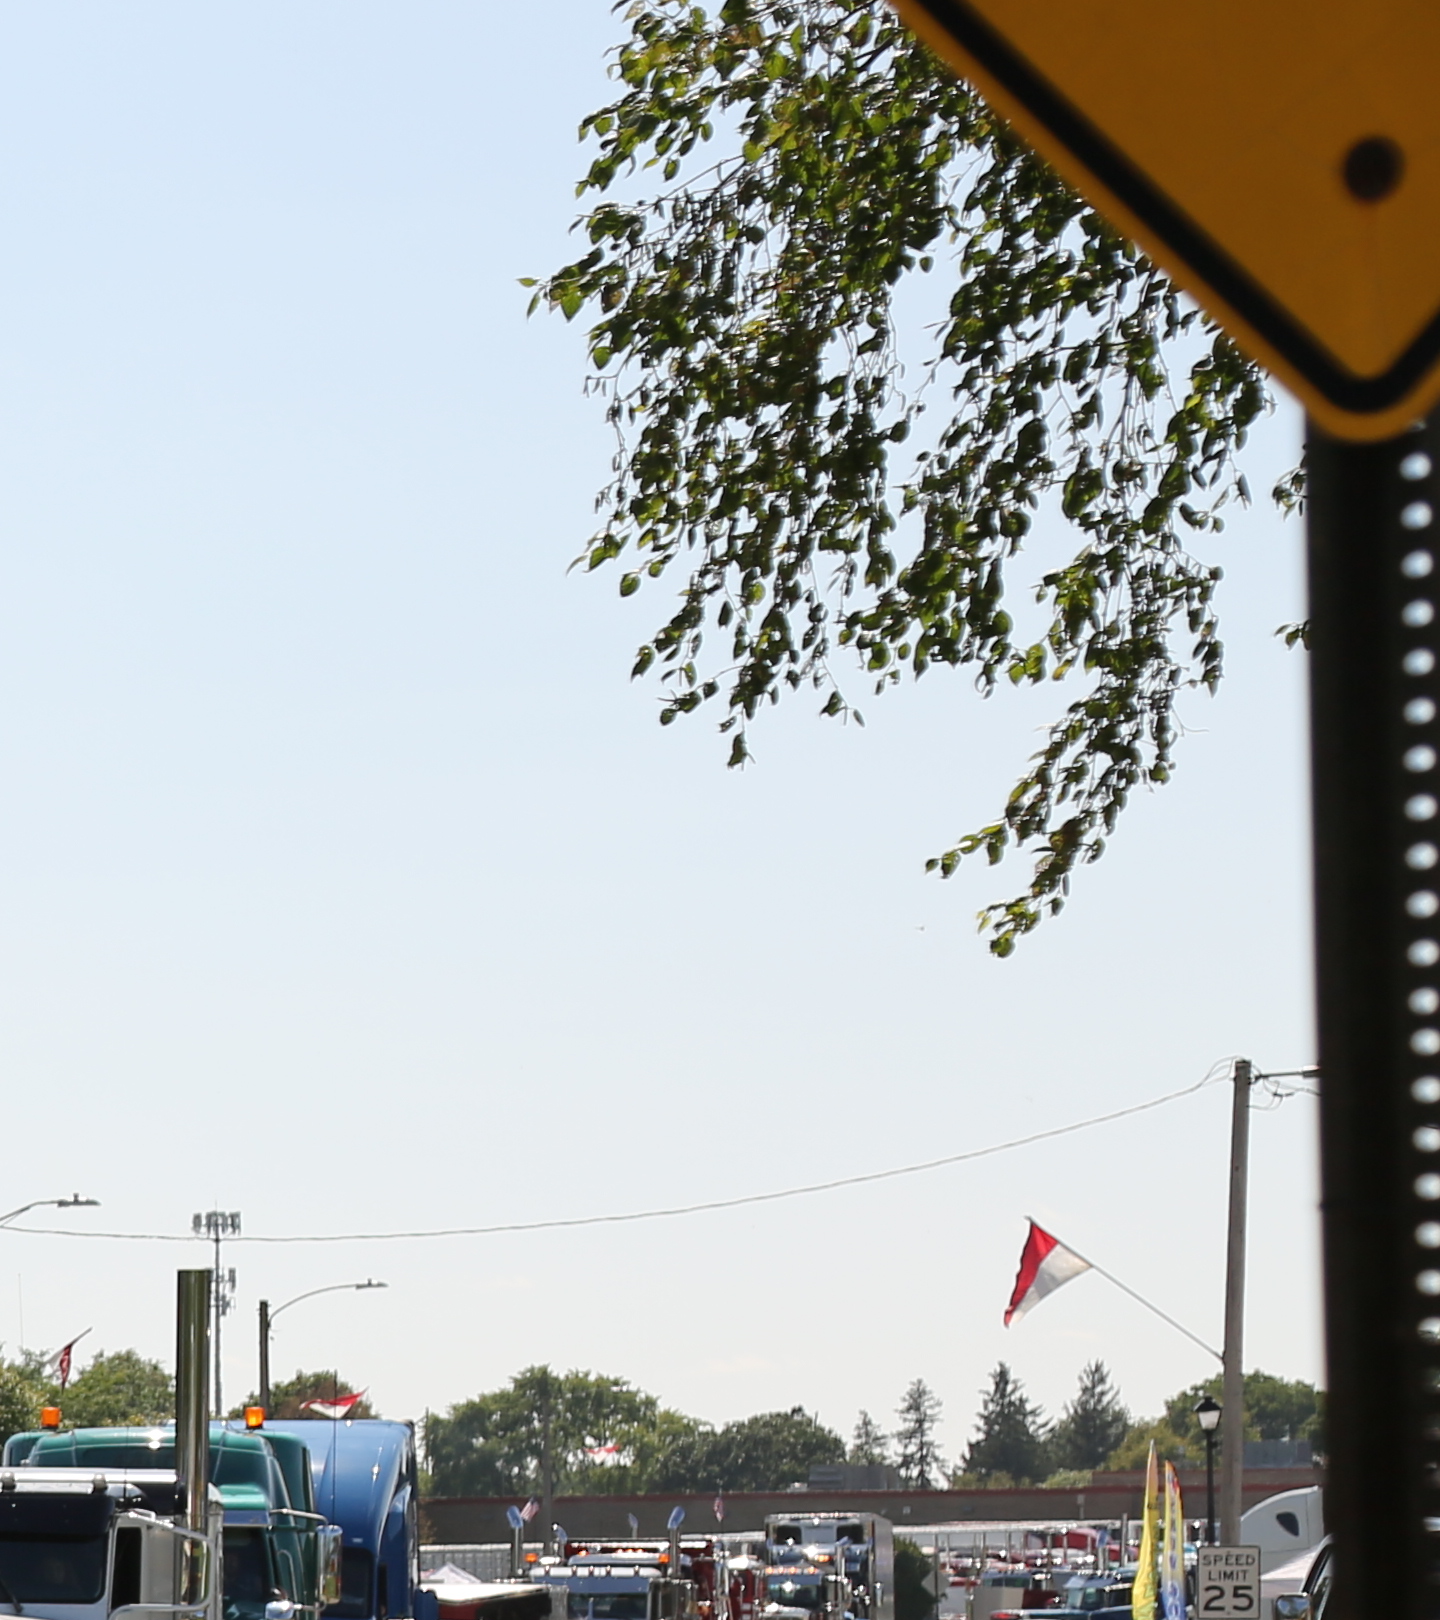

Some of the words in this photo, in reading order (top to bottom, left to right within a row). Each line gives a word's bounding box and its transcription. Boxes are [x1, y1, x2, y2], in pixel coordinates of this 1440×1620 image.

[1202, 1553, 1255, 1567] SPEED
[1208, 1569, 1249, 1582] LIMIT
[1203, 1585, 1254, 1612] 25
